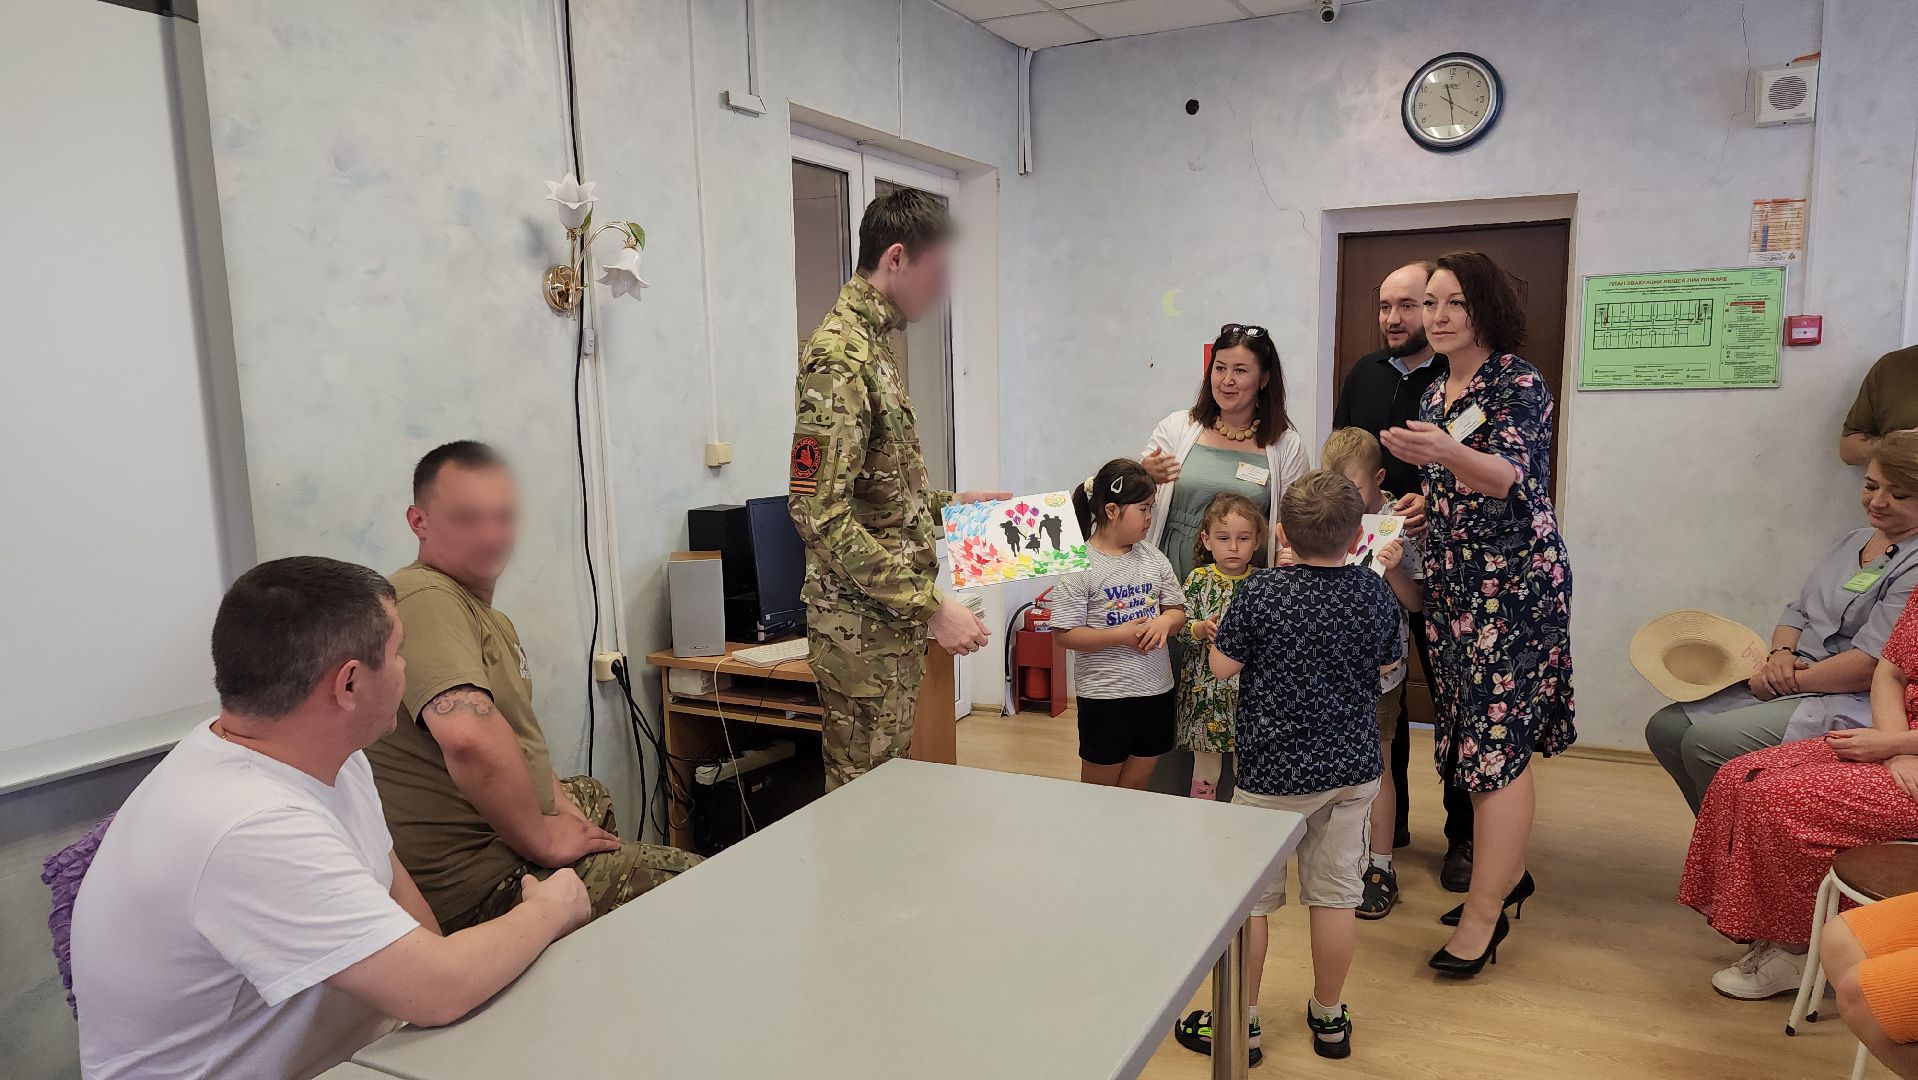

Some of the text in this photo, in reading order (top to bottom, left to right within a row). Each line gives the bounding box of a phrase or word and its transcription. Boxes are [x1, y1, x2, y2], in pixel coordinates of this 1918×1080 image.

[1449, 67, 1457, 76] 12
[1475, 80, 1482, 88] 2
[1479, 95, 1485, 104] 3
[1129, 597, 1146, 608] the
